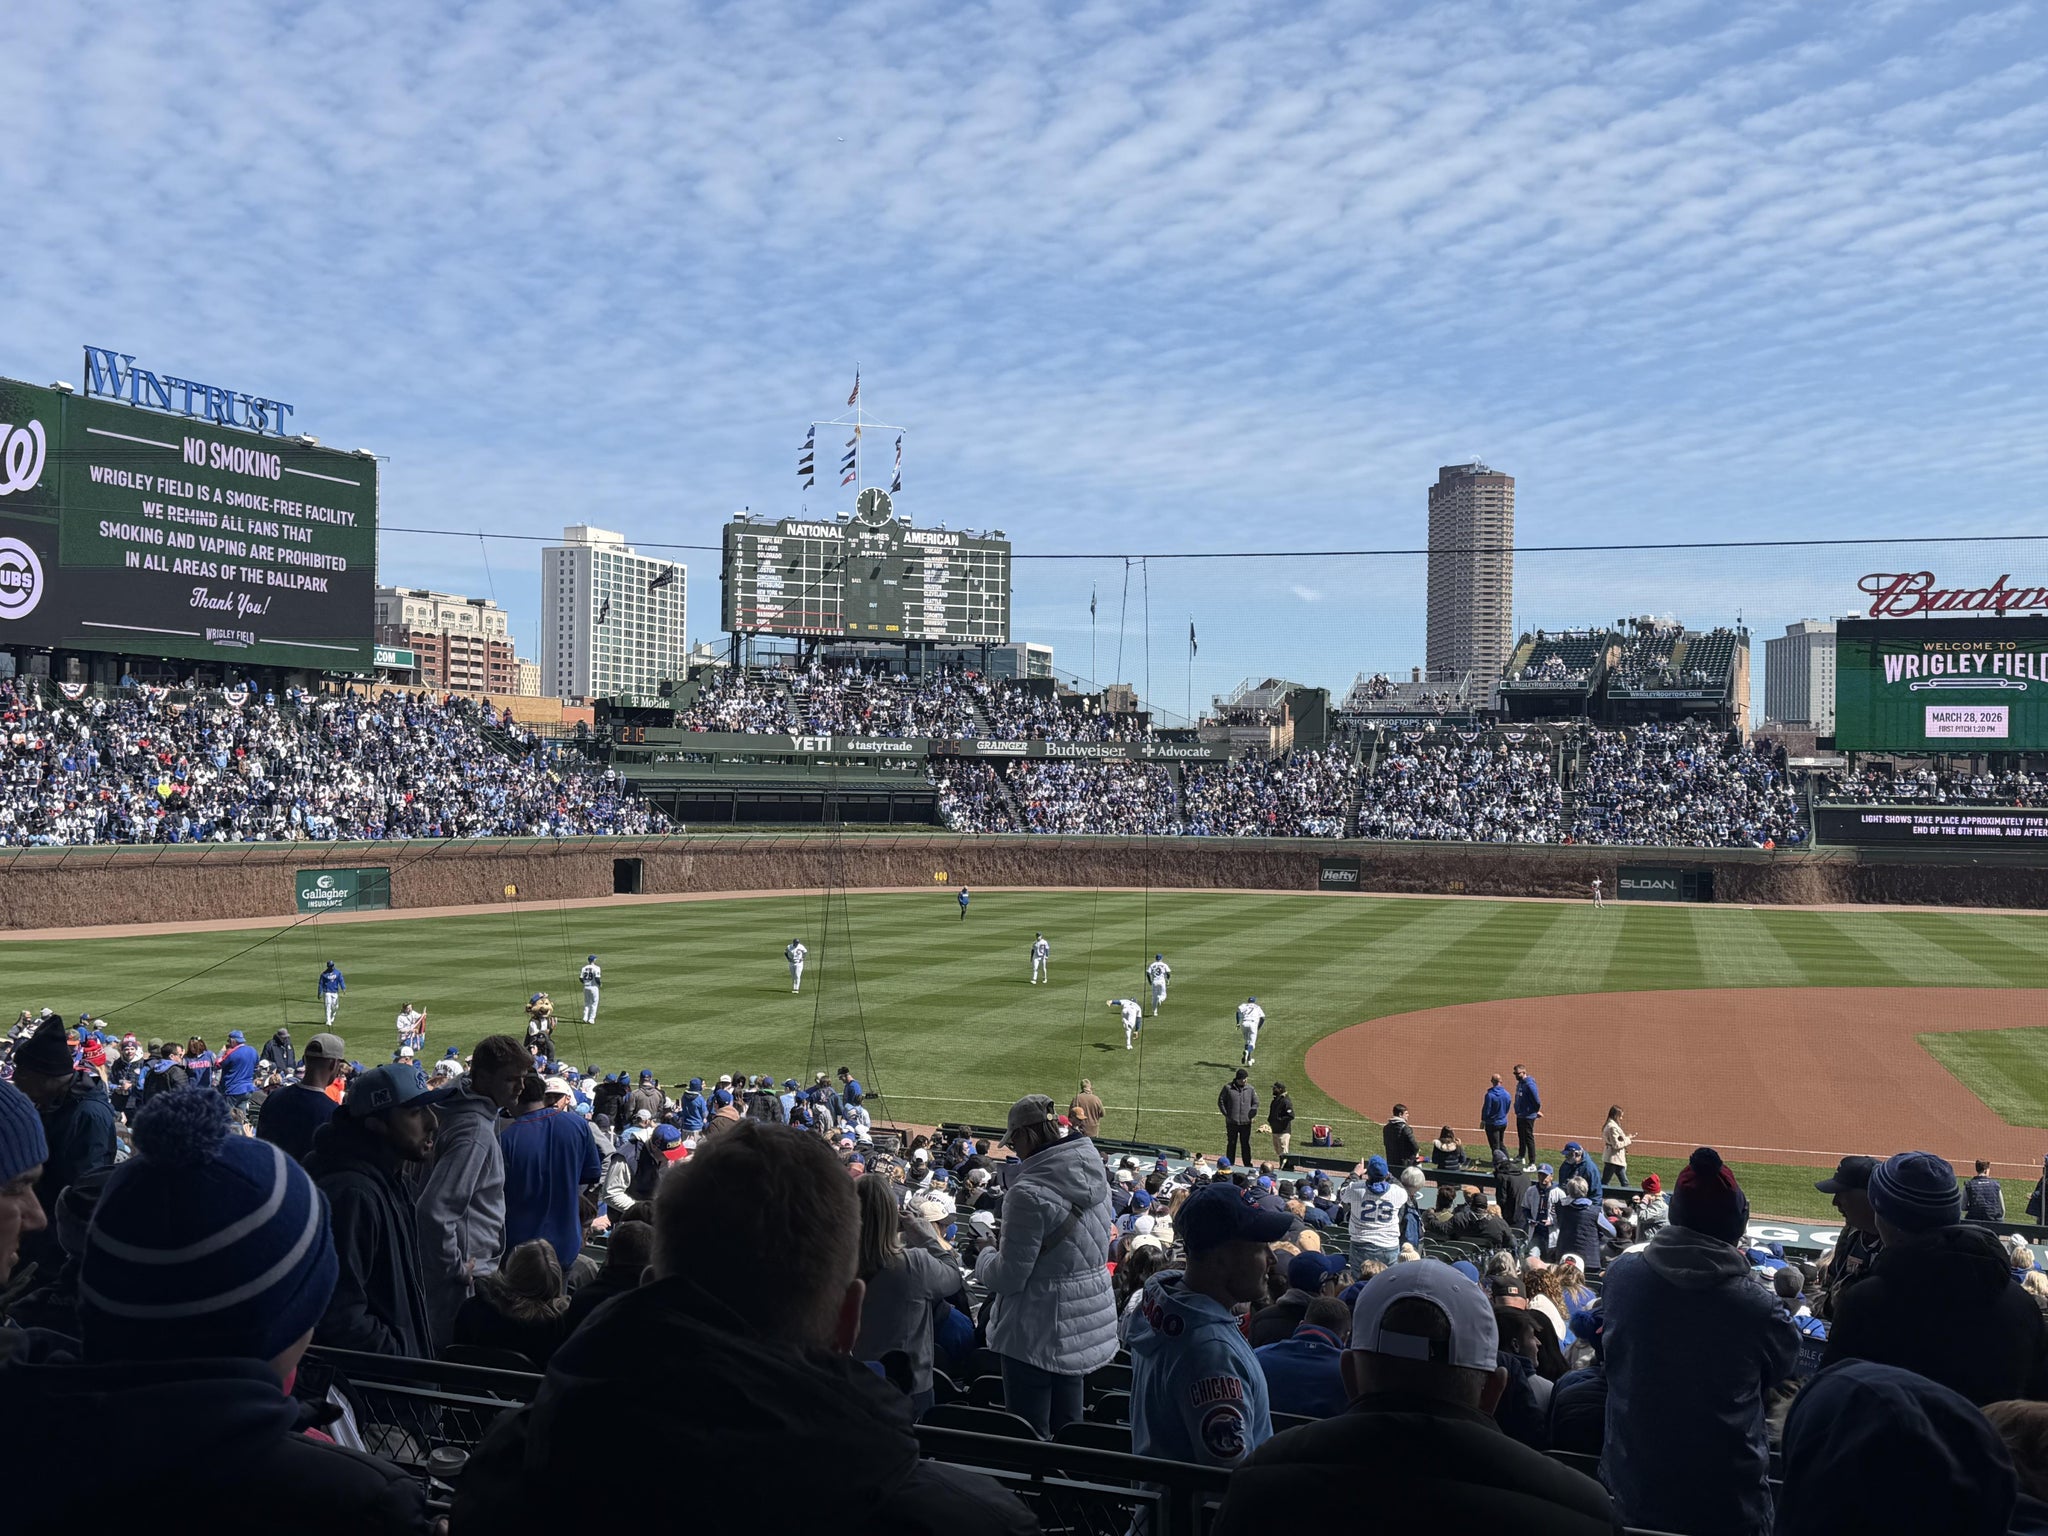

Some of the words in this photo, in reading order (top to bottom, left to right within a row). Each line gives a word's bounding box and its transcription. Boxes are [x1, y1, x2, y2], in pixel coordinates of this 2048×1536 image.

[84, 345, 293, 436] WINTRUST
[184, 436, 206, 466] NO
[210, 442, 280, 480] SMOKING
[90, 465, 153, 491] WRIGLEY
[157, 478, 193, 498] FIELD
[198, 485, 210, 501] IS
[213, 488, 222, 504] A
[226, 490, 302, 518] SMOKE-FREE
[306, 504, 358, 527] FACILITY.
[142, 501, 163, 519] WE
[168, 506, 217, 528] REMIND
[221, 515, 244, 532] ALL
[248, 519, 279, 538] FANS
[282, 524, 312, 543] THAT
[786, 524, 844, 538] NATIONAL
[903, 532, 959, 546] AMERICAN
[100, 521, 163, 544] SMOKING
[167, 532, 195, 549] AND
[199, 536, 246, 557] VAPING
[250, 544, 274, 561] ARE
[278, 548, 346, 572] PROHIBITED
[126, 551, 139, 568] IN
[143, 554, 169, 572] ALL
[173, 558, 217, 578] AREAS
[221, 564, 236, 580] OF
[240, 567, 263, 584] THE
[267, 571, 328, 593] BALLPARK
[190, 587, 233, 611] Thank
[238, 593, 271, 619] You!
[206, 627, 235, 640] WRIGLEY
[236, 630, 254, 645] FIELD
[1924, 642, 1993, 651] WELCOME
[1998, 642, 2016, 650] TO
[1884, 654, 1987, 684] WRIGLEY
[1993, 653, 2048, 684] FIELD
[641, 698, 670, 708] Mobile
[1932, 713, 1962, 723] MARCH
[1964, 713, 1978, 723] 28,
[1980, 713, 2002, 722] 2026
[623, 727, 645, 742] 2:15
[791, 737, 831, 751] YETI
[855, 740, 912, 753] tastytrade
[976, 741, 1028, 750] GRAINGER
[1158, 746, 1210, 757] Advocate
[1861, 815, 1883, 823] LIGHT
[1884, 815, 1912, 824] SHOWS
[1914, 816, 1933, 824] TAKE
[1935, 816, 1959, 824] PLACE
[1961, 816, 2023, 826] APPROXIMATELY
[2026, 818, 2043, 826] FIVE
[1913, 826, 1928, 834] END
[1930, 826, 1939, 834] OF
[1941, 827, 1956, 835] THE
[1958, 827, 1972, 835] 8TH
[2005, 828, 2021, 836] AND
[2024, 828, 2048, 837] AFTER
[934, 872, 947, 880] 400
[1323, 871, 1355, 881] Hefty
[302, 888, 348, 900] Gallagher
[1361, 1200, 1394, 1223] 23
[1190, 1376, 1243, 1408] CHICAGO
